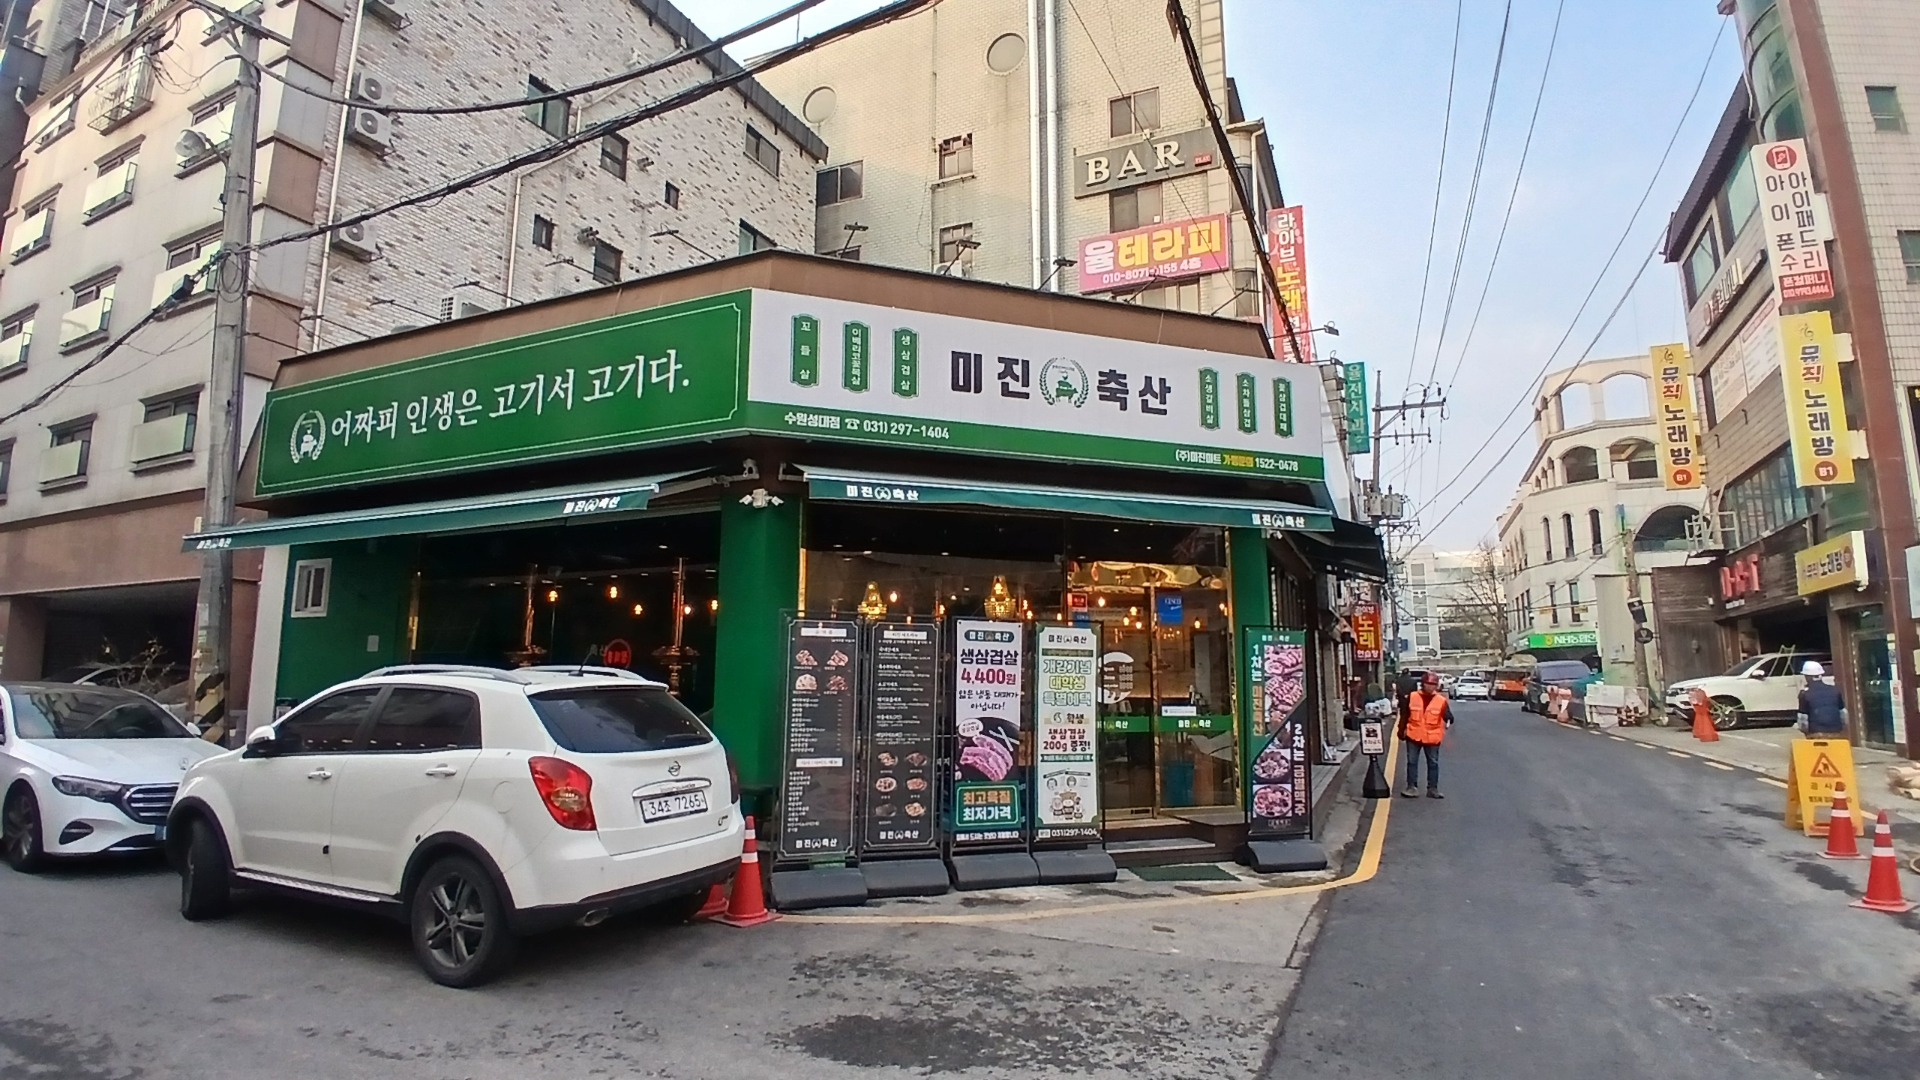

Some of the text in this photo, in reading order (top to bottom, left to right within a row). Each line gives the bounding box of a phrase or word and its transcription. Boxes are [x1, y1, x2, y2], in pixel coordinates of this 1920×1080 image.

[1085, 140, 1185, 187] BAR
[1276, 212, 1297, 263] 라이브
[901, 335, 911, 390] 생삼겹살
[950, 350, 1171, 417] 미진 축산
[331, 349, 690, 447] 어짜피 인생은 고기서 고기다.
[1799, 345, 1835, 456] 뮤직 노래방
[1661, 366, 1691, 465] 뮤직 노래방
[784, 411, 841, 430] 수원성대점
[890, 422, 950, 440] 297-1404
[1255, 457, 1299, 472] 1522-0478
[1818, 464, 1834, 478] B1
[1676, 472, 1688, 482] B1
[1358, 615, 1375, 649] 노래
[960, 648, 1019, 666] 생삼겹살
[961, 667, 1017, 685] 4,400원
[1043, 659, 1092, 675] 개강기념
[1049, 675, 1086, 690] 대학생
[1066, 712, 1085, 724] 학생
[1048, 728, 1086, 740] 생삼겹살
[1043, 740, 1068, 752] 200g
[649, 794, 702, 816] 34조 7265
[963, 805, 1012, 821] 최저가격
